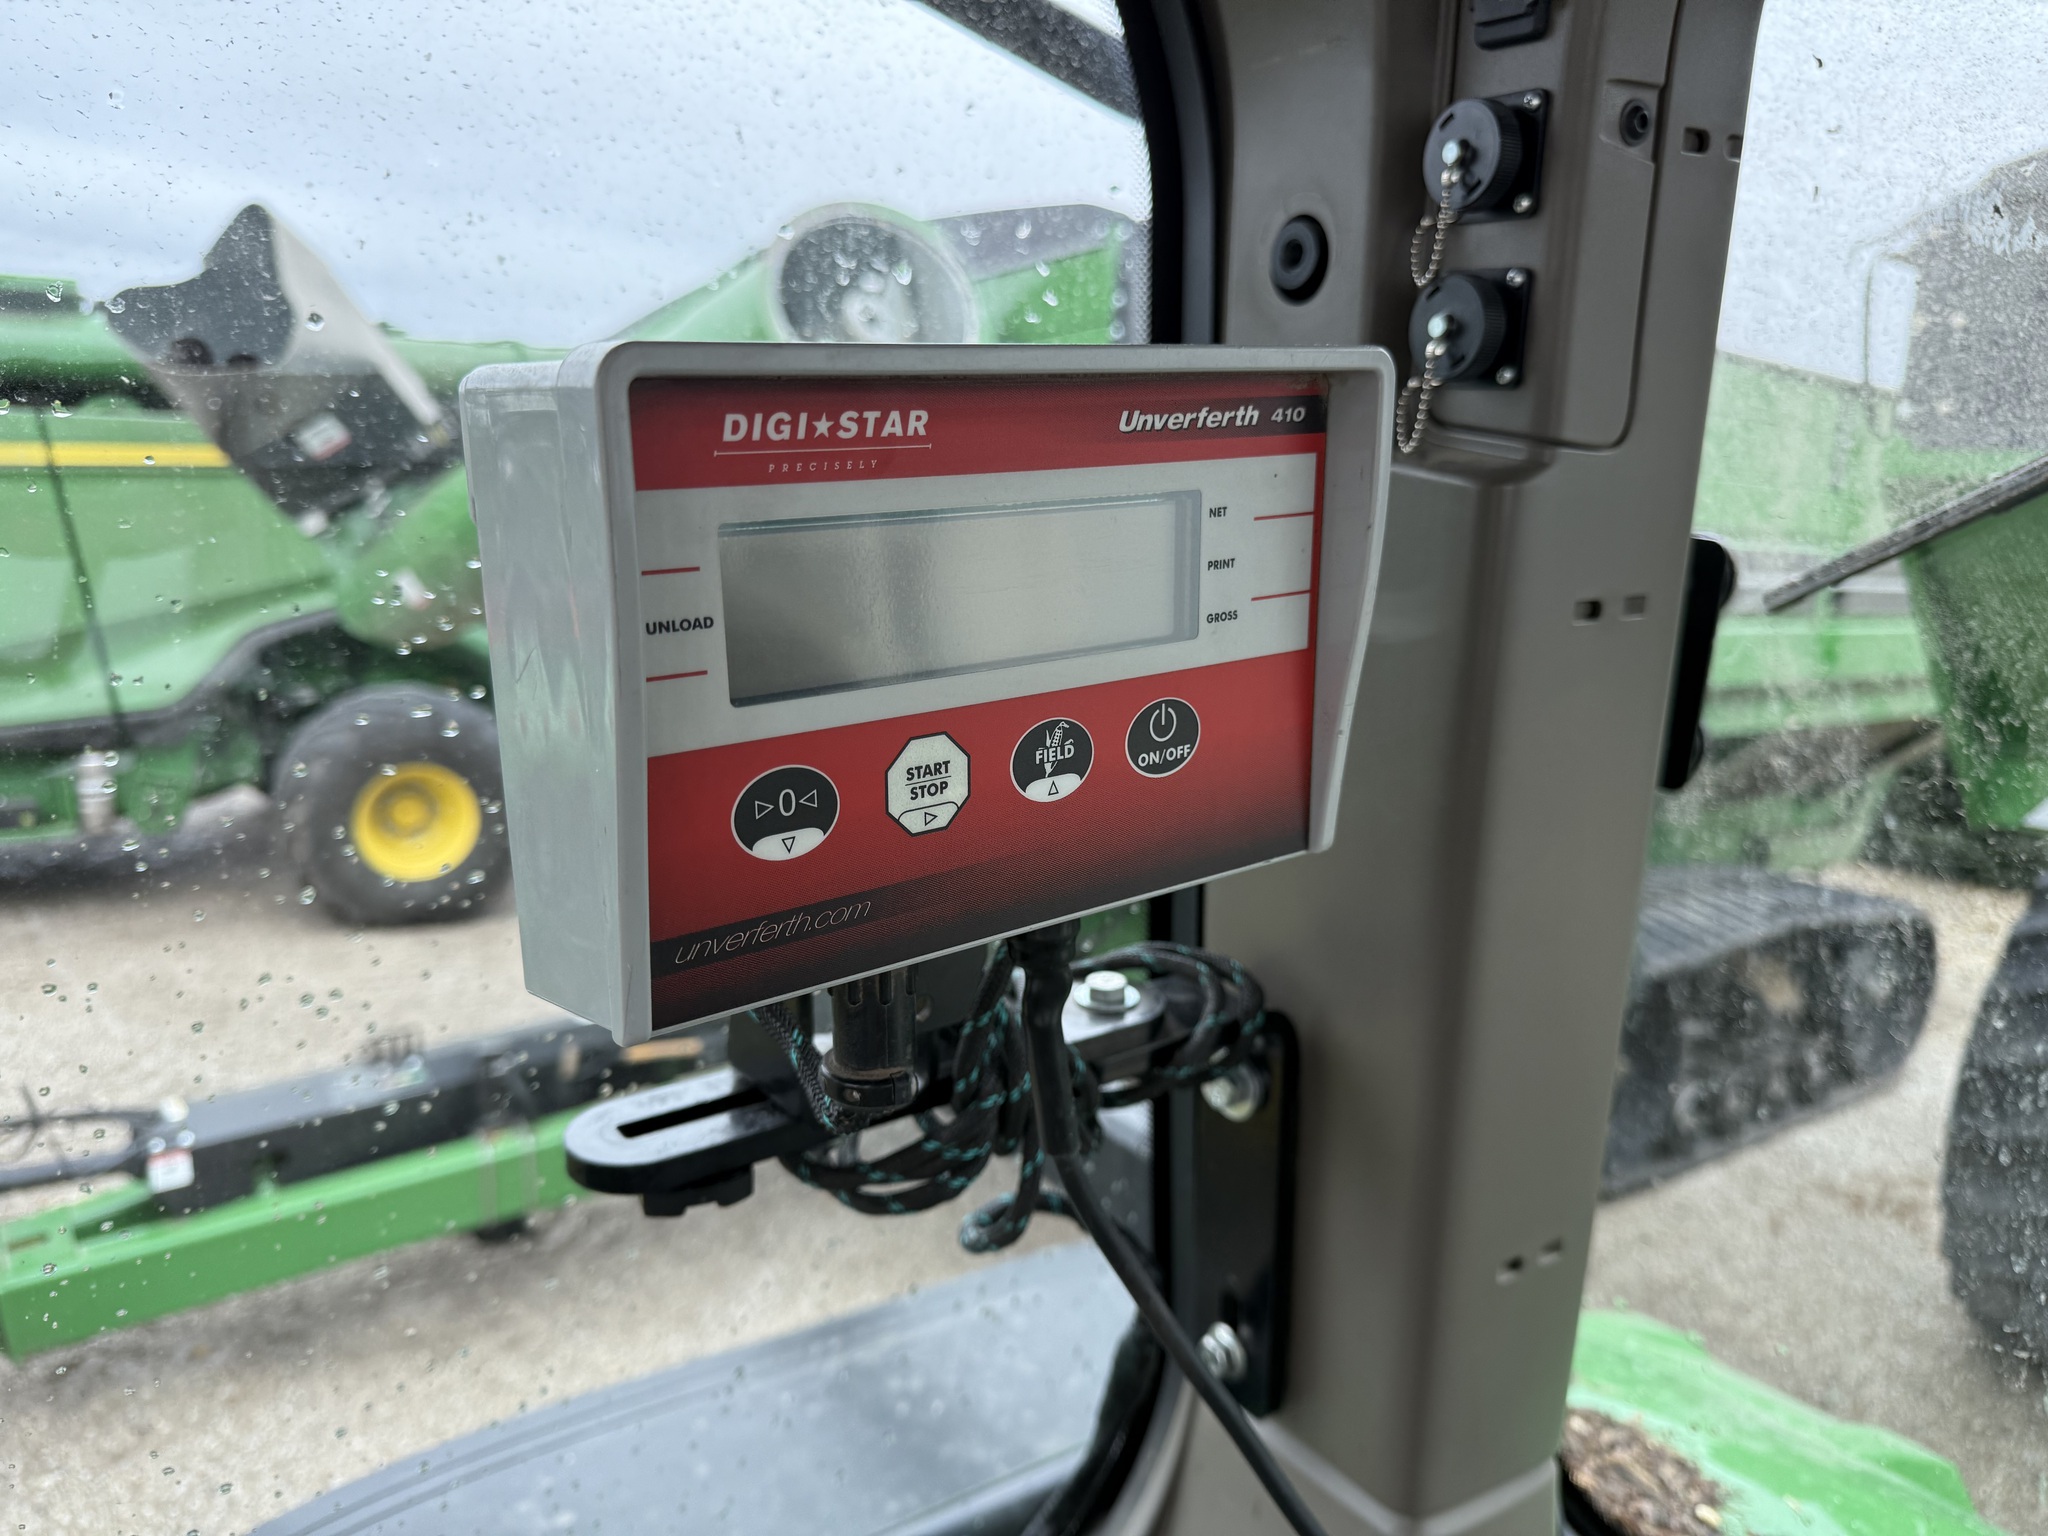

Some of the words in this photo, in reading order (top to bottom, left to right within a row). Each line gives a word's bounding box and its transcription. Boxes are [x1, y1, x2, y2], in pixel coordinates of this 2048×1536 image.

[1118, 405, 1260, 433] Unverferth
[1271, 407, 1306, 424] 410
[768, 459, 879, 473] PRECISELY
[1209, 507, 1227, 518] NET
[1207, 558, 1236, 571] PRINT
[645, 616, 714, 635] UNLOAD
[1206, 610, 1238, 624] GROSS
[1035, 745, 1075, 765] FIELD
[1137, 744, 1191, 767] ON/OFF
[905, 760, 951, 782] START
[910, 780, 949, 801] STOP
[675, 900, 872, 965] unverferth.com
